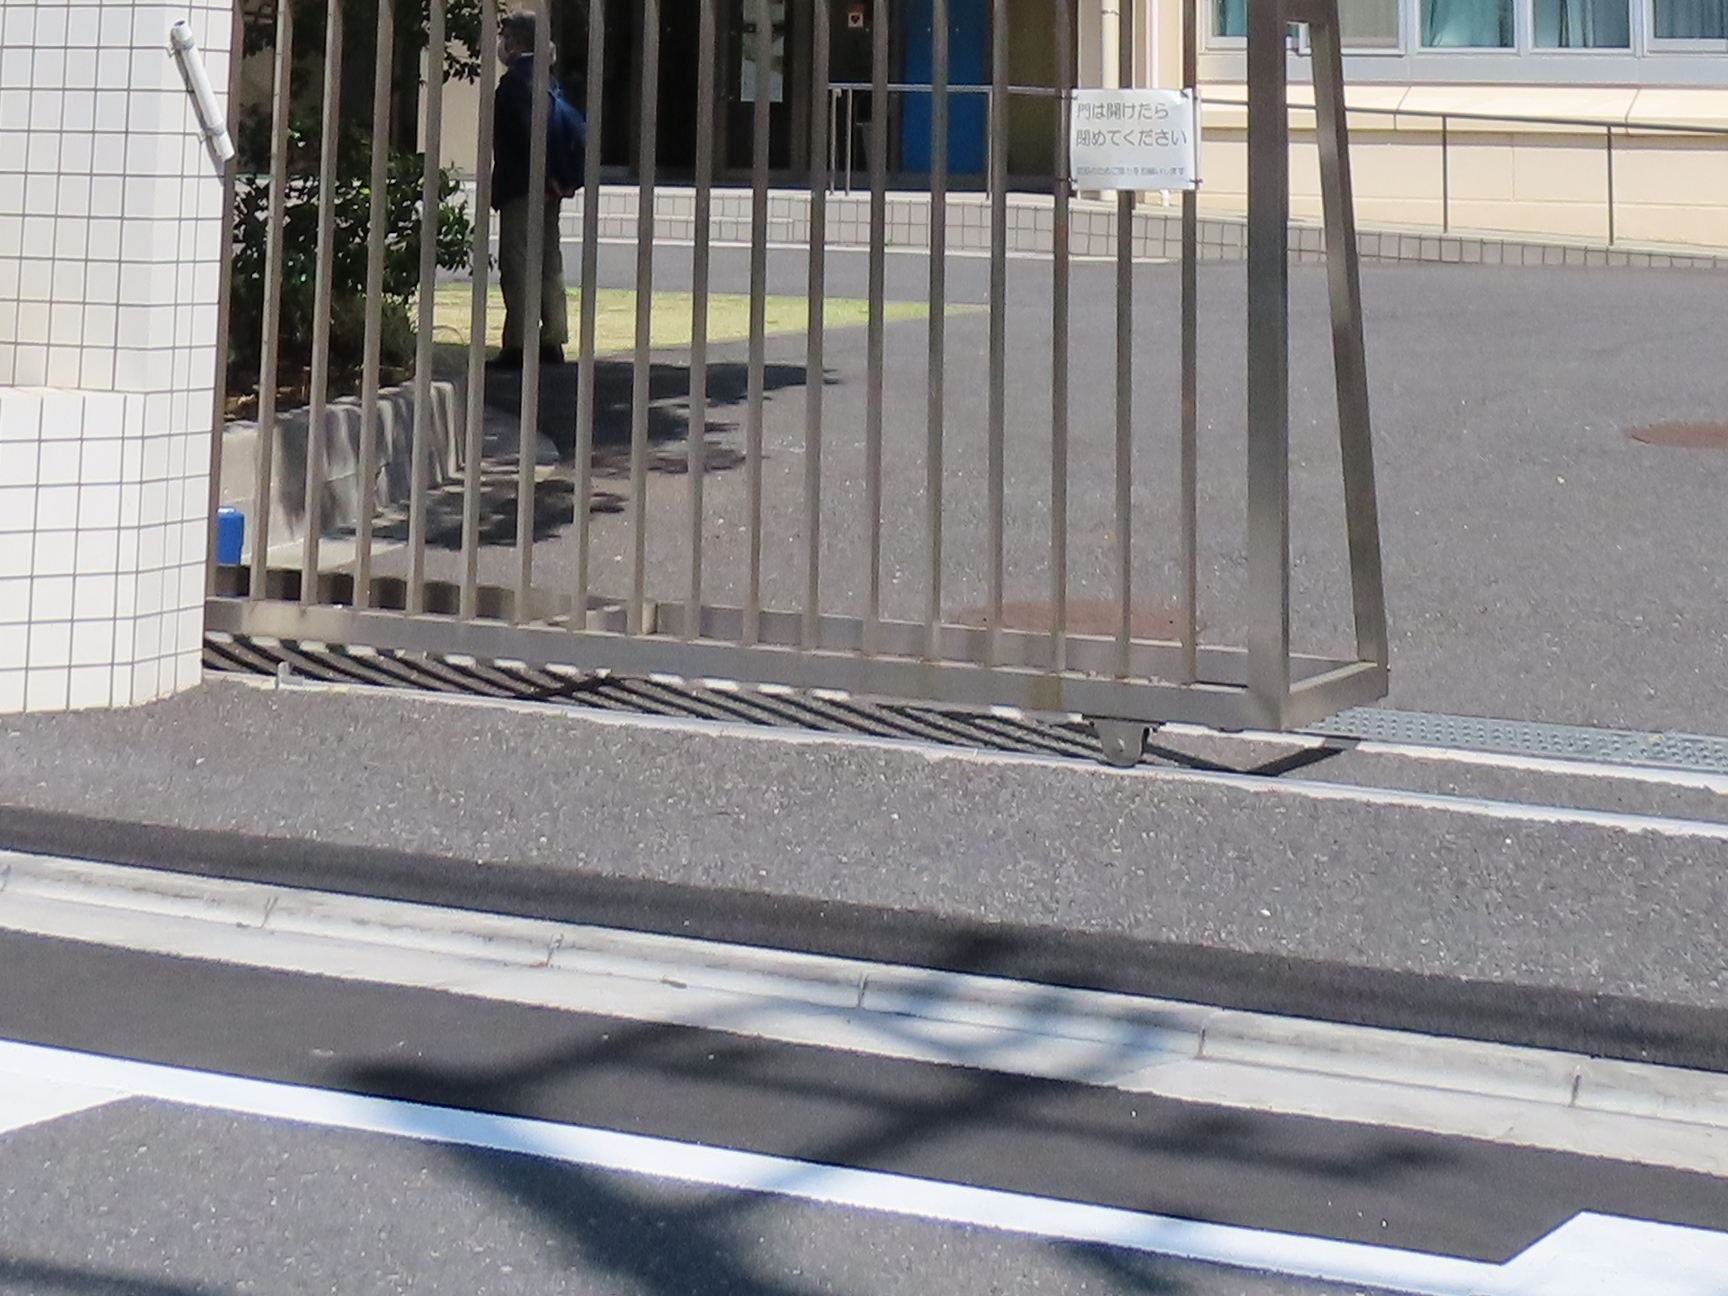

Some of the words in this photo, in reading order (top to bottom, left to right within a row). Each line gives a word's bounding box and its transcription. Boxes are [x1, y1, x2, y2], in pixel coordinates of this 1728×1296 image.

[1076, 102, 1169, 120] 門は開けたら
[1076, 129, 1187, 147] 閉めてください
